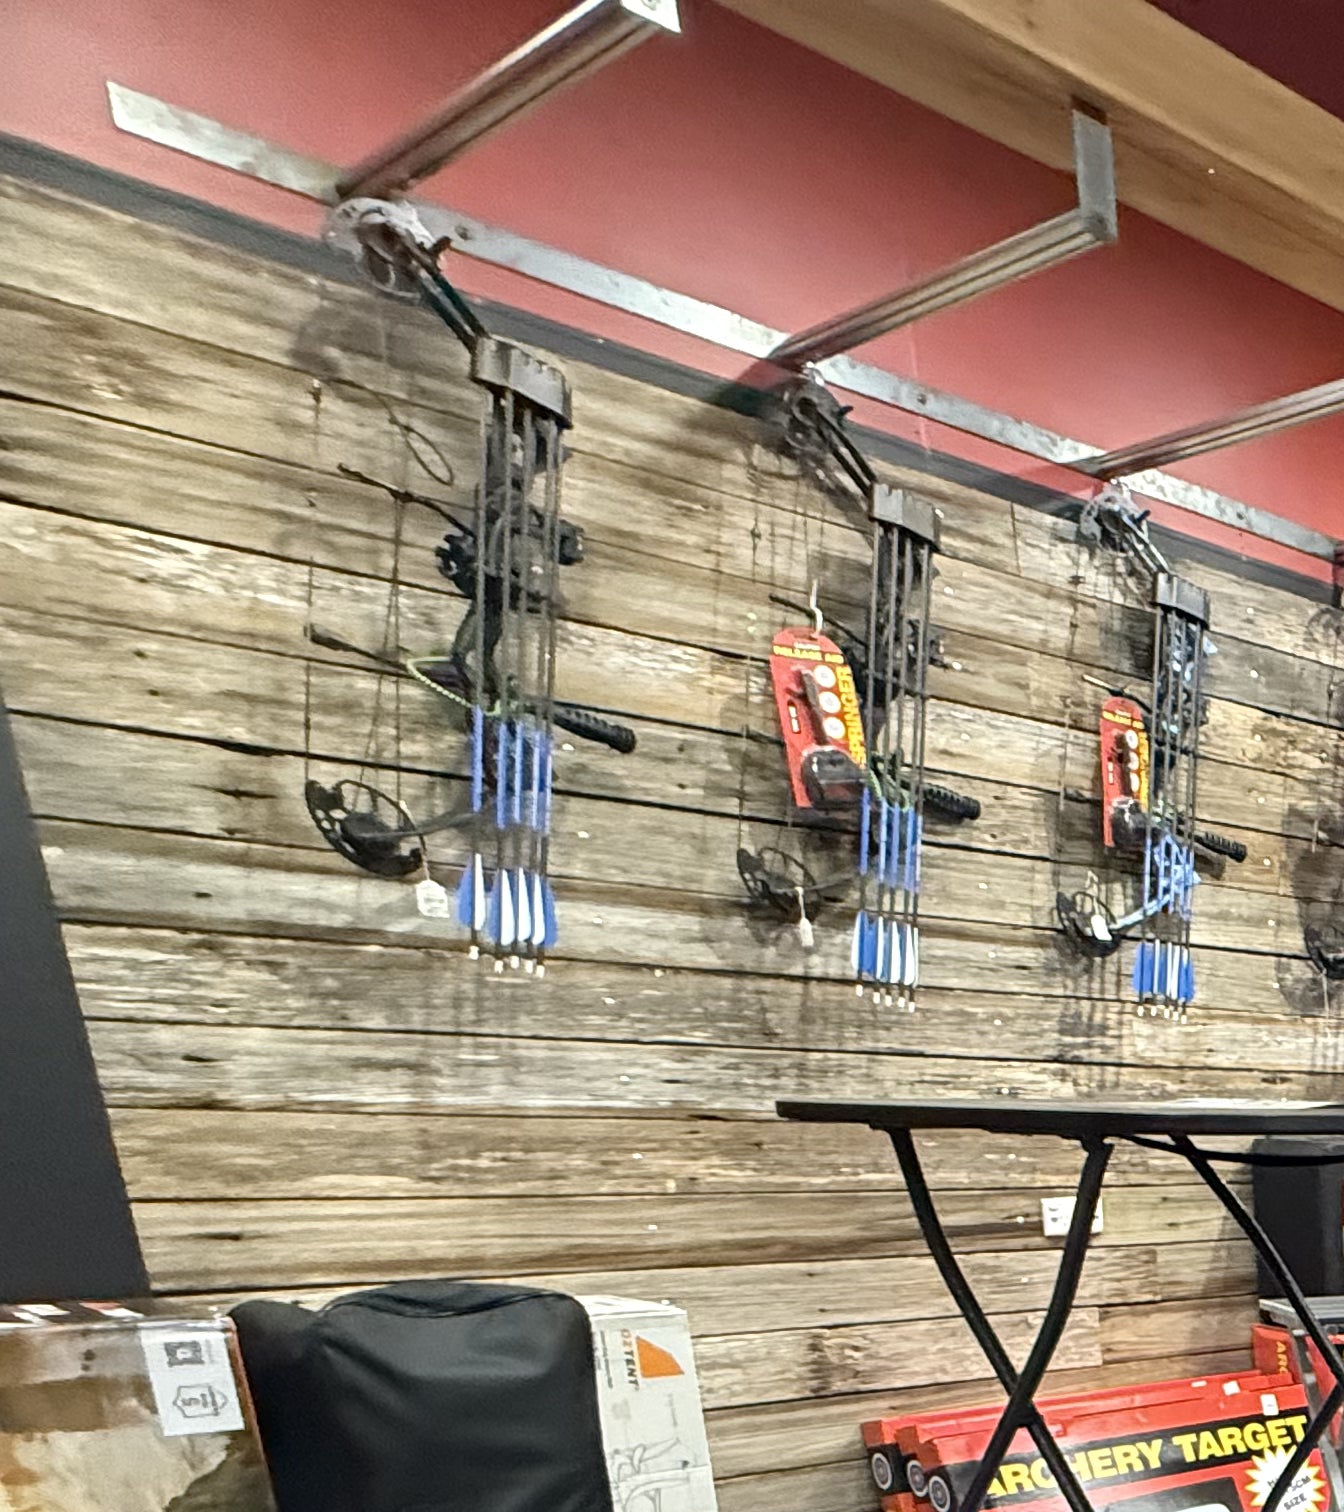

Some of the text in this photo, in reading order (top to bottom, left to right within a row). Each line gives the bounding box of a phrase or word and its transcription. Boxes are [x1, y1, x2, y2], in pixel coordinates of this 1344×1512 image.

[836, 665, 867, 769] SPRINGER
[986, 1415, 1308, 1500] ARCHERY TARGET
[1283, 1495, 1308, 1511] SIZE
